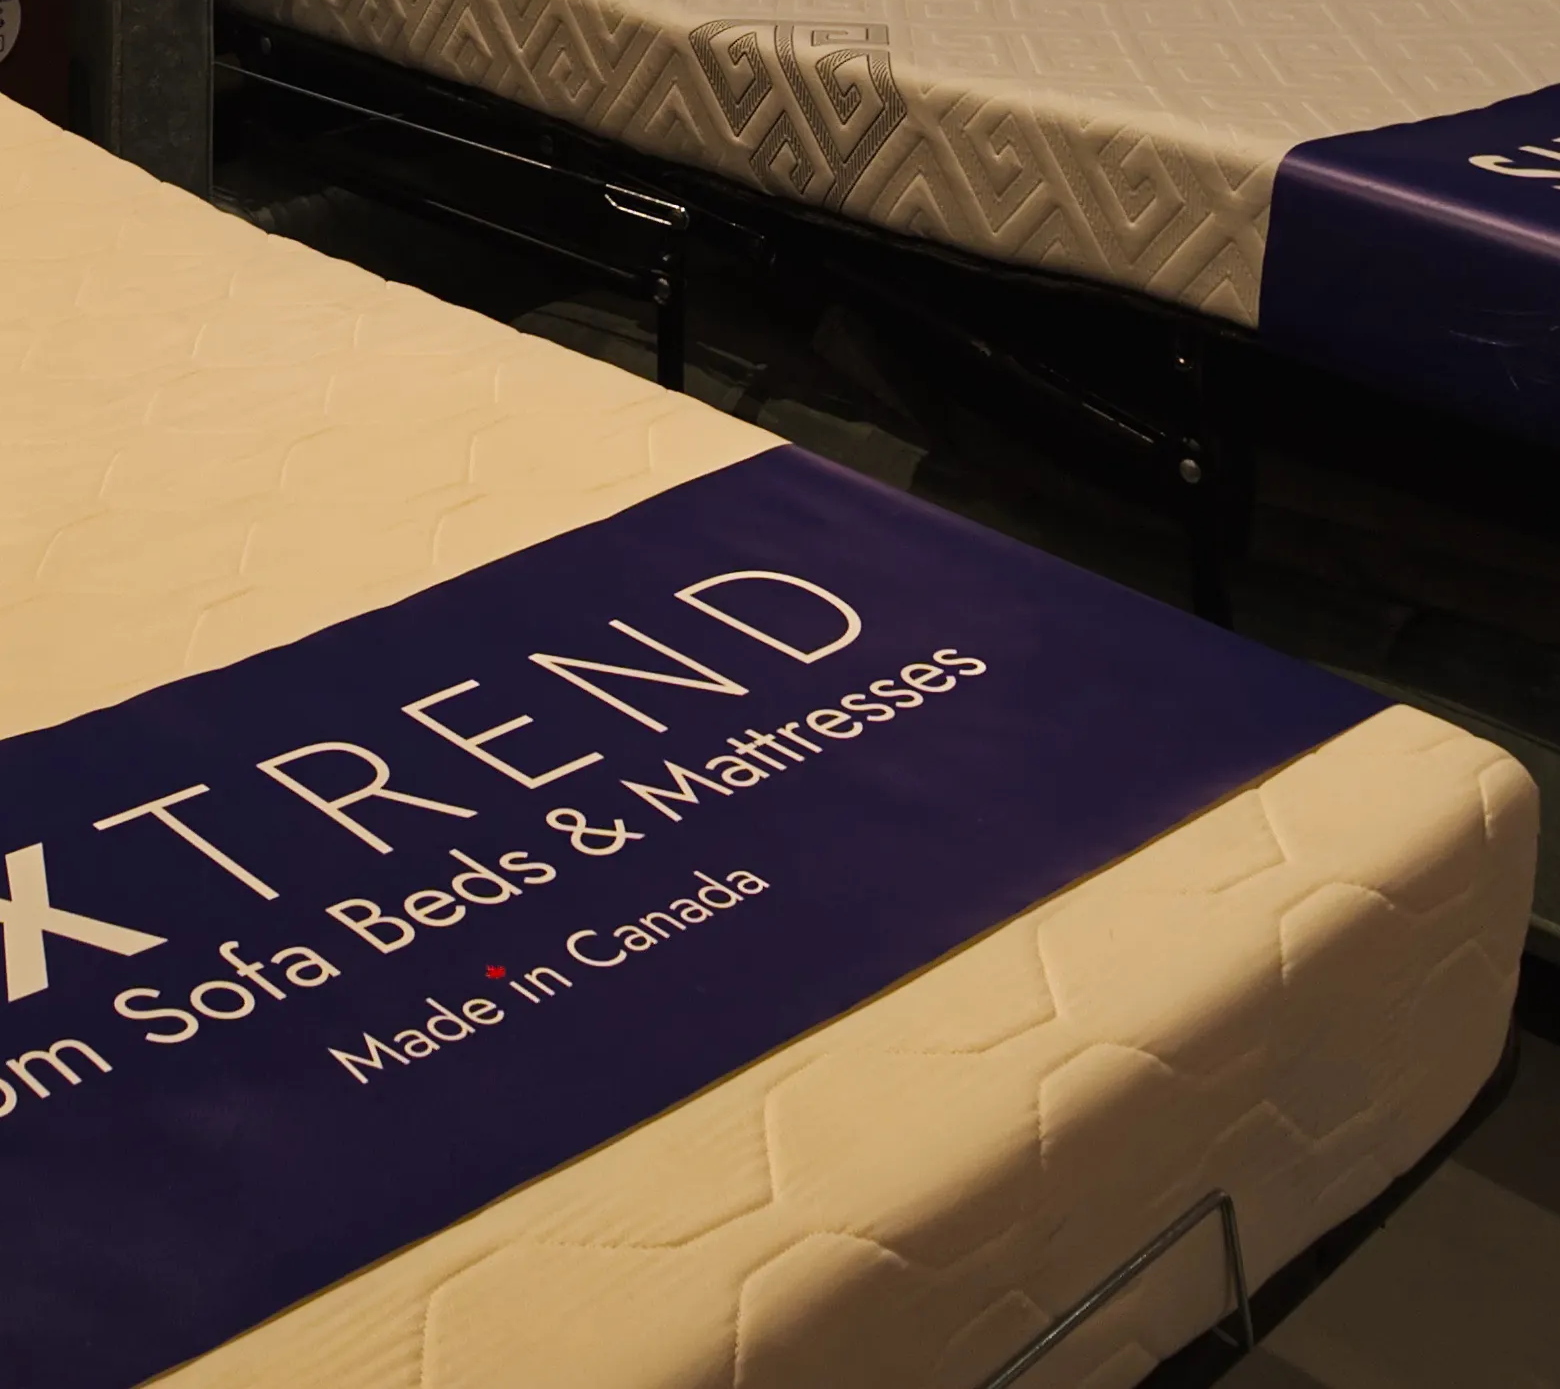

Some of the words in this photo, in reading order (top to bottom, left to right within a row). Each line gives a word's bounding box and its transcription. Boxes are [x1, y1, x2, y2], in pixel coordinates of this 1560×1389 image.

[111, 934, 342, 1046] Sofa
[324, 847, 558, 954] Beds
[544, 806, 646, 857] &
[620, 645, 988, 823] Mattresses
[327, 996, 505, 1085] Made
[508, 965, 573, 1004] in
[565, 869, 771, 968] Canada
